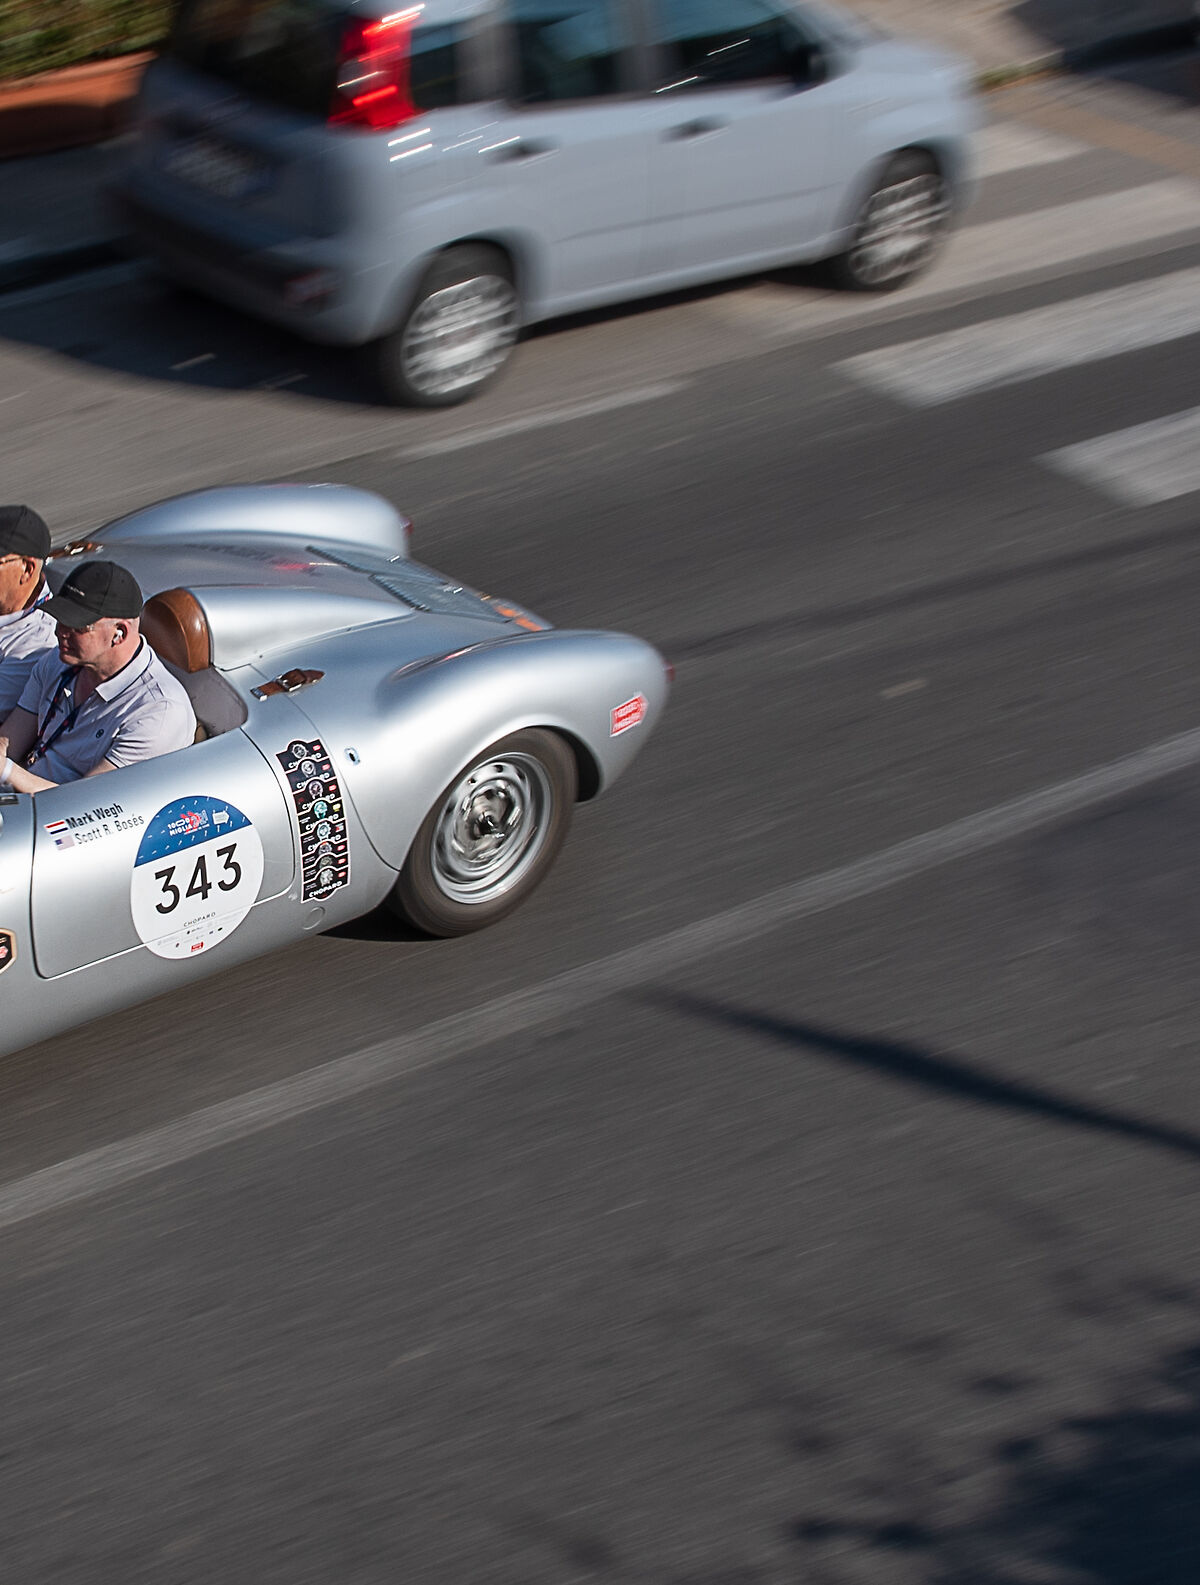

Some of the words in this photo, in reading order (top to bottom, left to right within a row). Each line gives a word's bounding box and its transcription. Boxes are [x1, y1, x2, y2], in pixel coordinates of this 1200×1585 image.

[66, 812, 95, 829] Mark
[92, 803, 124, 820] Wegh
[74, 827, 103, 845] Scott
[114, 813, 145, 832] Bosés
[169, 823, 193, 837] MIGLIA
[154, 842, 242, 915] 343
[308, 881, 343, 898] CHOPARD
[183, 911, 217, 927] CHOPARD
